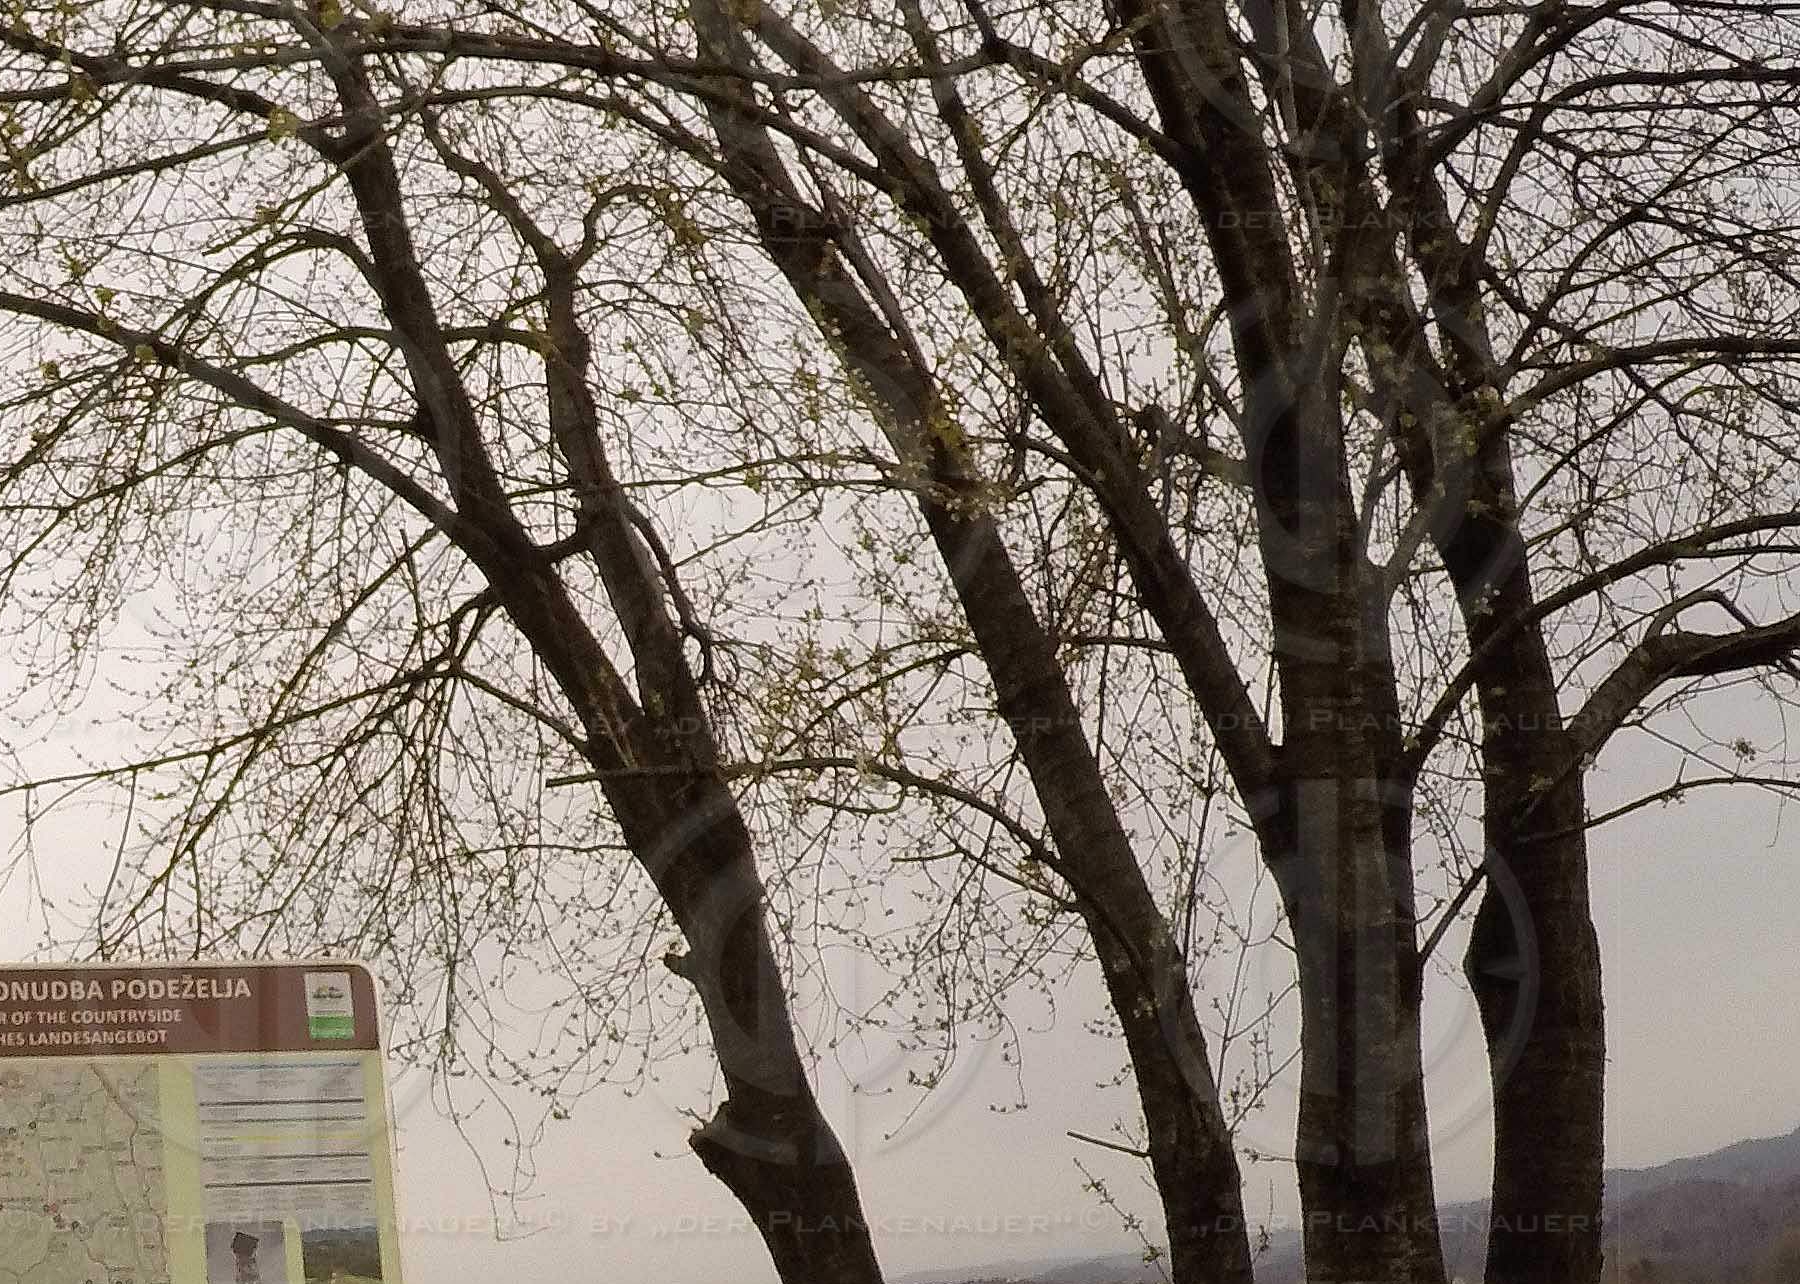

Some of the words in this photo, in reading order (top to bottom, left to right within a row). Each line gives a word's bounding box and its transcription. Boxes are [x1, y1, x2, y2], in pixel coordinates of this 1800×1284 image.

[111, 974, 251, 1000] PODEŽELJA
[11, 1010, 34, 1025] OF
[37, 1009, 66, 1024] THE
[70, 1008, 182, 1024] COUNTRYSIDE
[28, 1029, 168, 1046] LANDESANGEBOT
